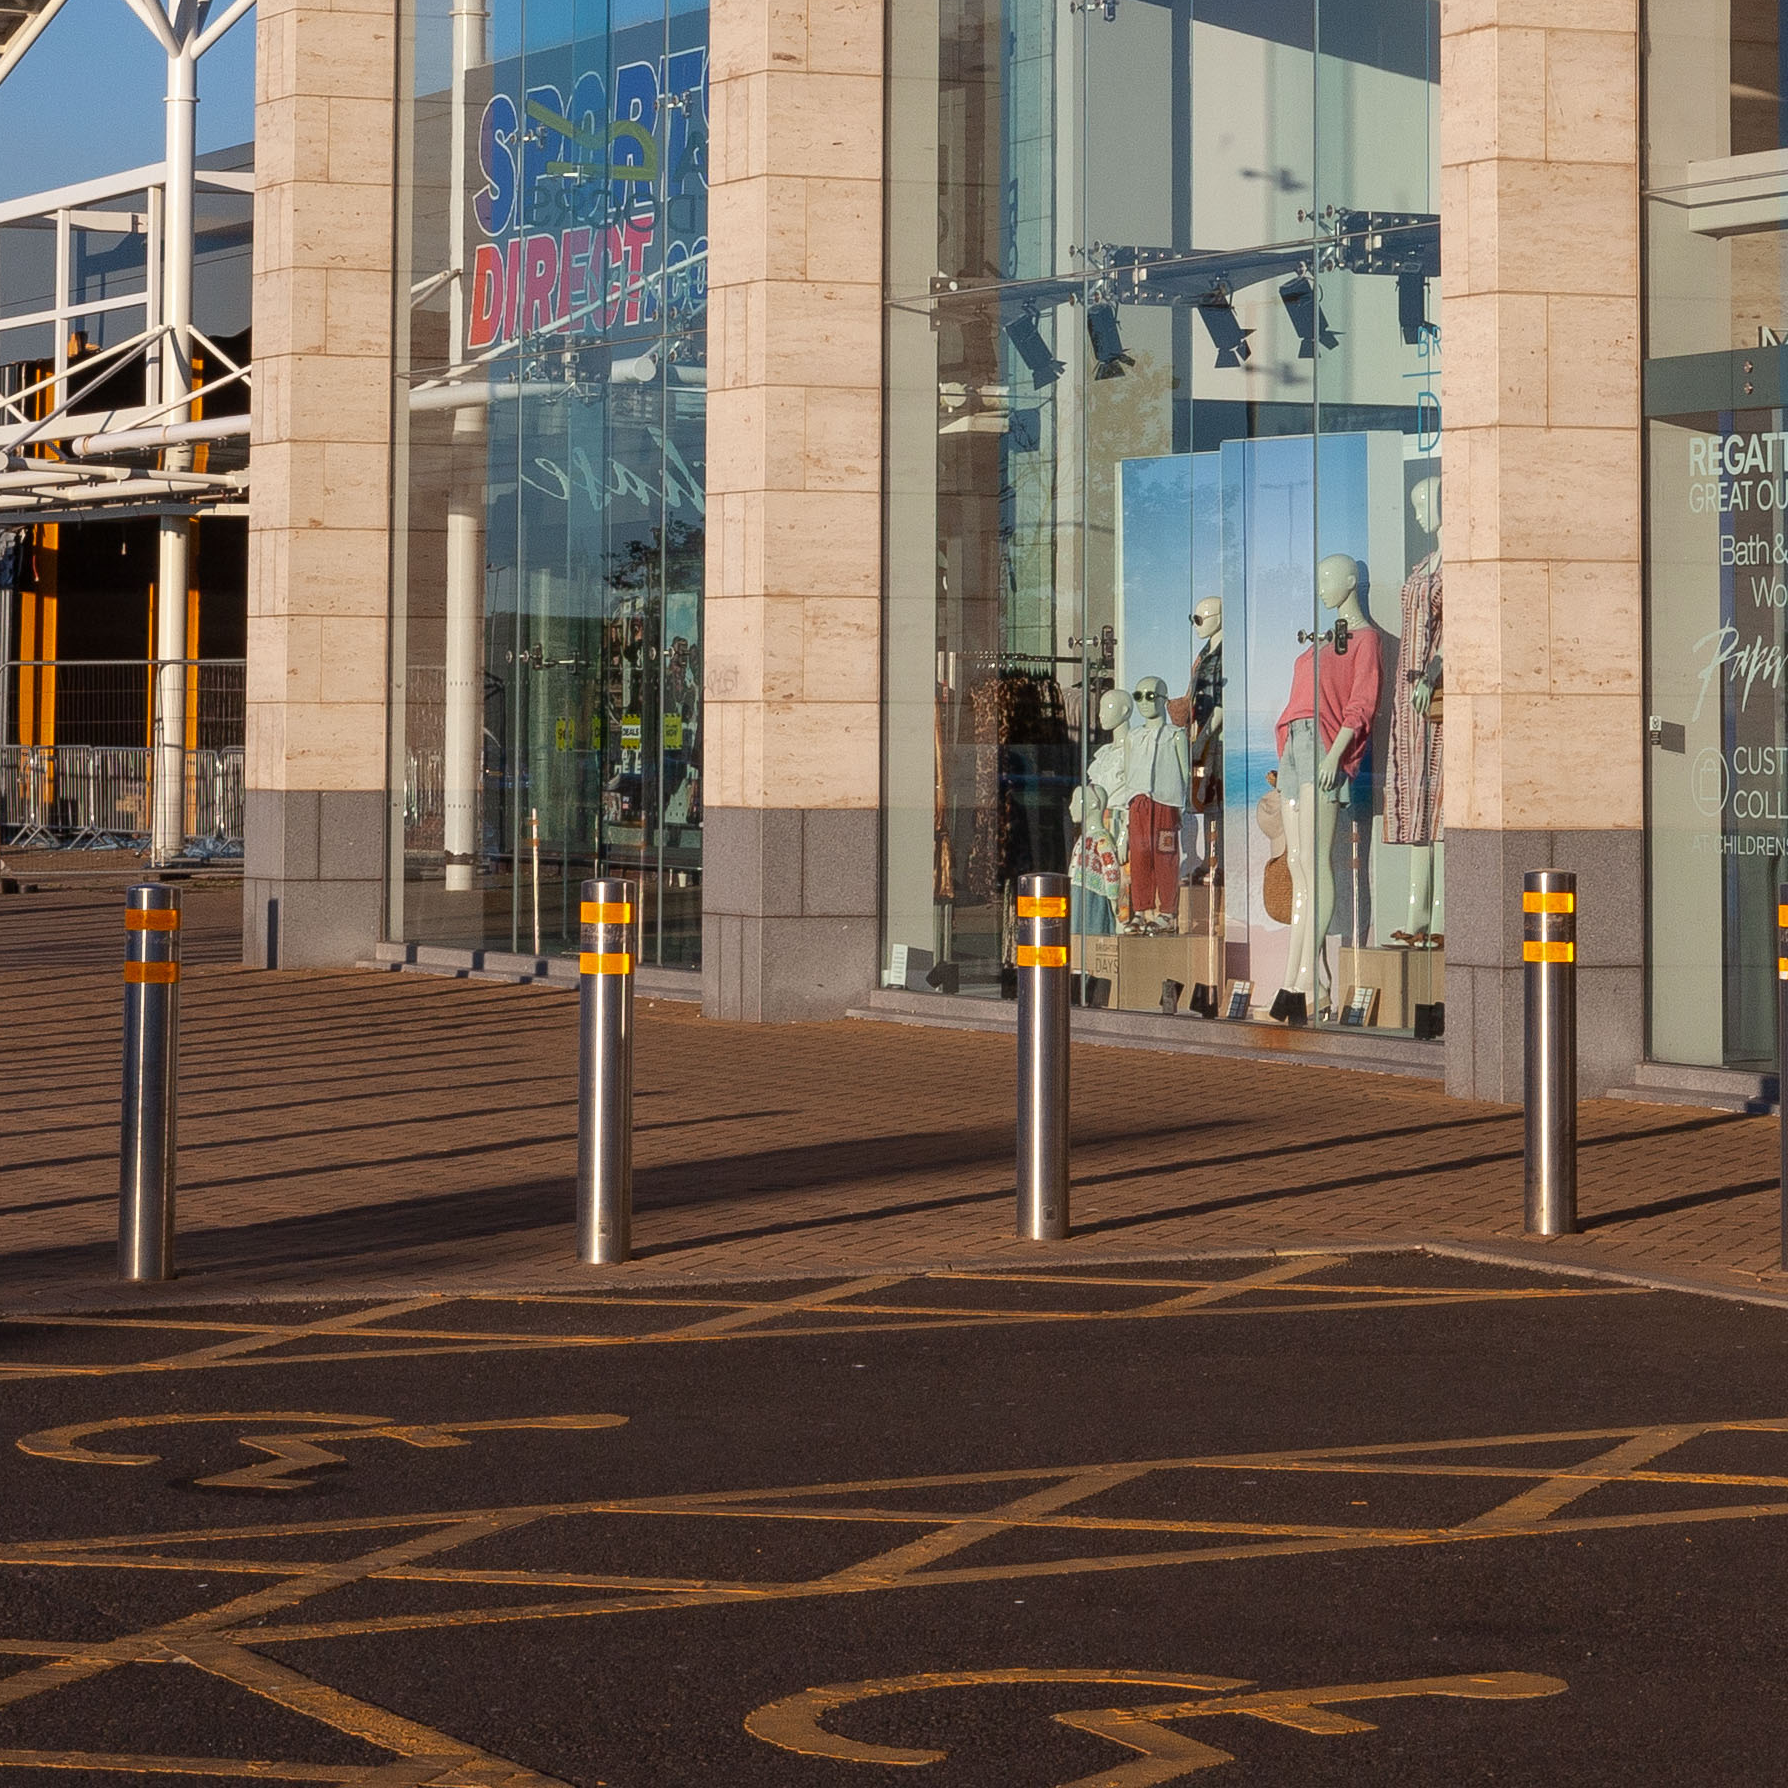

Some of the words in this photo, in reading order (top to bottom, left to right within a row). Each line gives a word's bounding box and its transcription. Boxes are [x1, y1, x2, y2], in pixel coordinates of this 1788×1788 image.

[472, 46, 709, 237] SPORT
[1689, 480, 1753, 513] GREAT
[1720, 534, 1770, 566] Bath
[1773, 533, 1788, 564] &
[1691, 835, 1709, 854] AT
